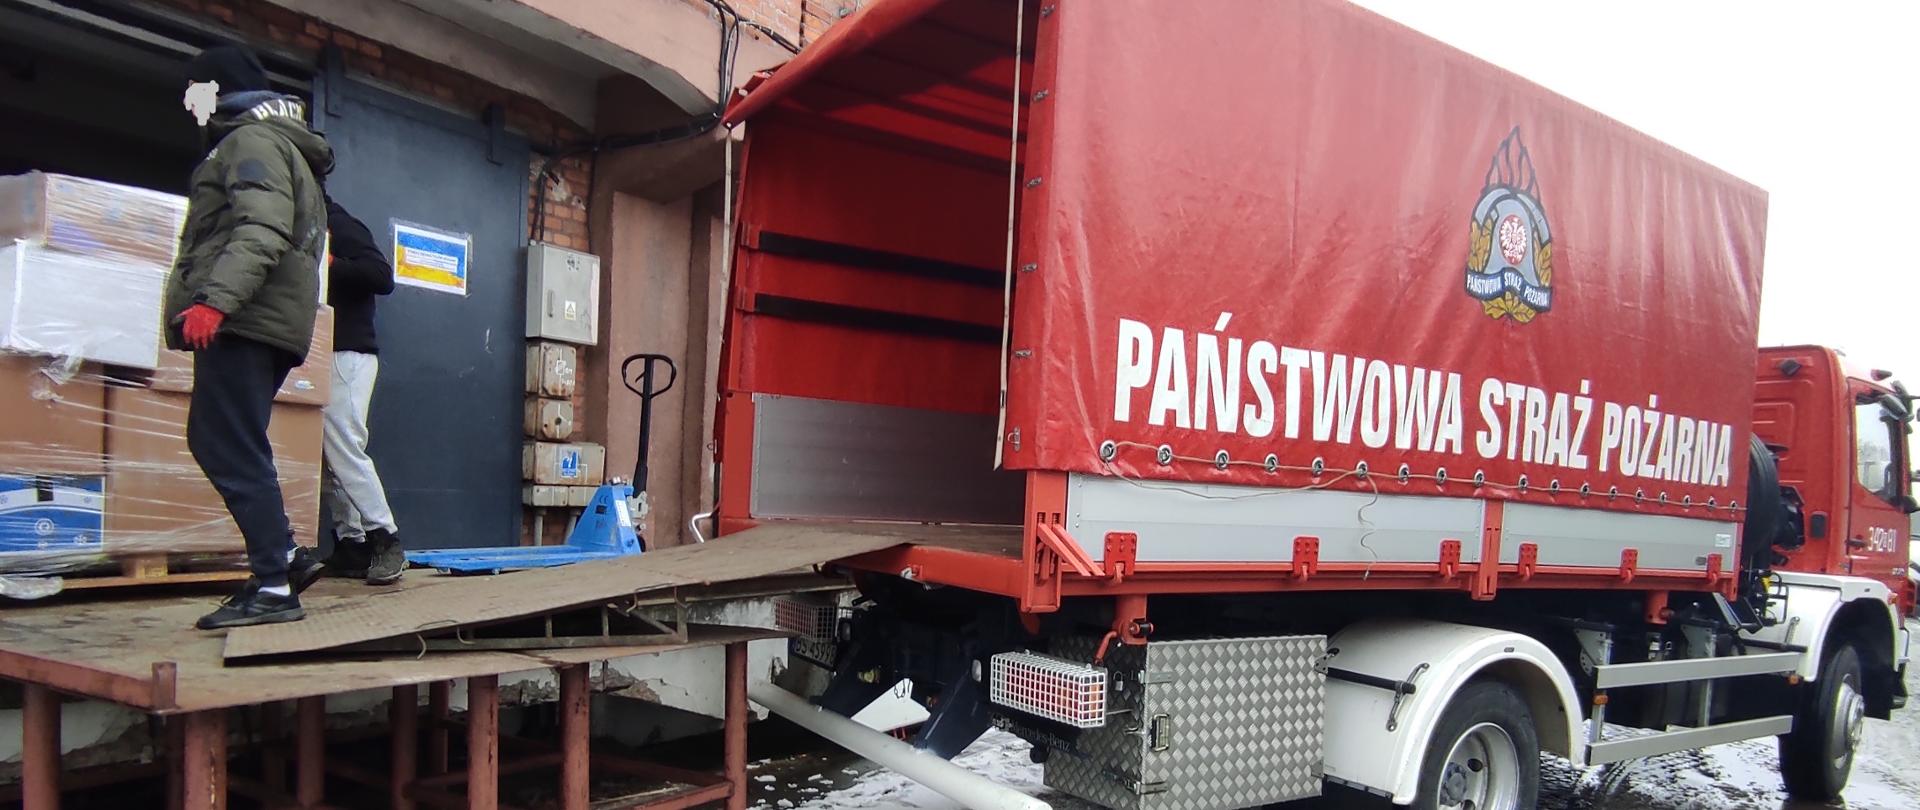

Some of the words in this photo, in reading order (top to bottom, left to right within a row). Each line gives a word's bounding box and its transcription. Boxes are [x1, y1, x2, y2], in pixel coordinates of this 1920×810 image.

[1467, 273, 1501, 295] PAŃSTWOWA
[1504, 272, 1523, 291] STRAŻ
[1524, 286, 1548, 306] POŻARNA
[1114, 312, 1463, 455] PAŃSTWOWA
[1477, 379, 1591, 471] STRAŻ
[1600, 395, 1733, 488] POŻARNA
